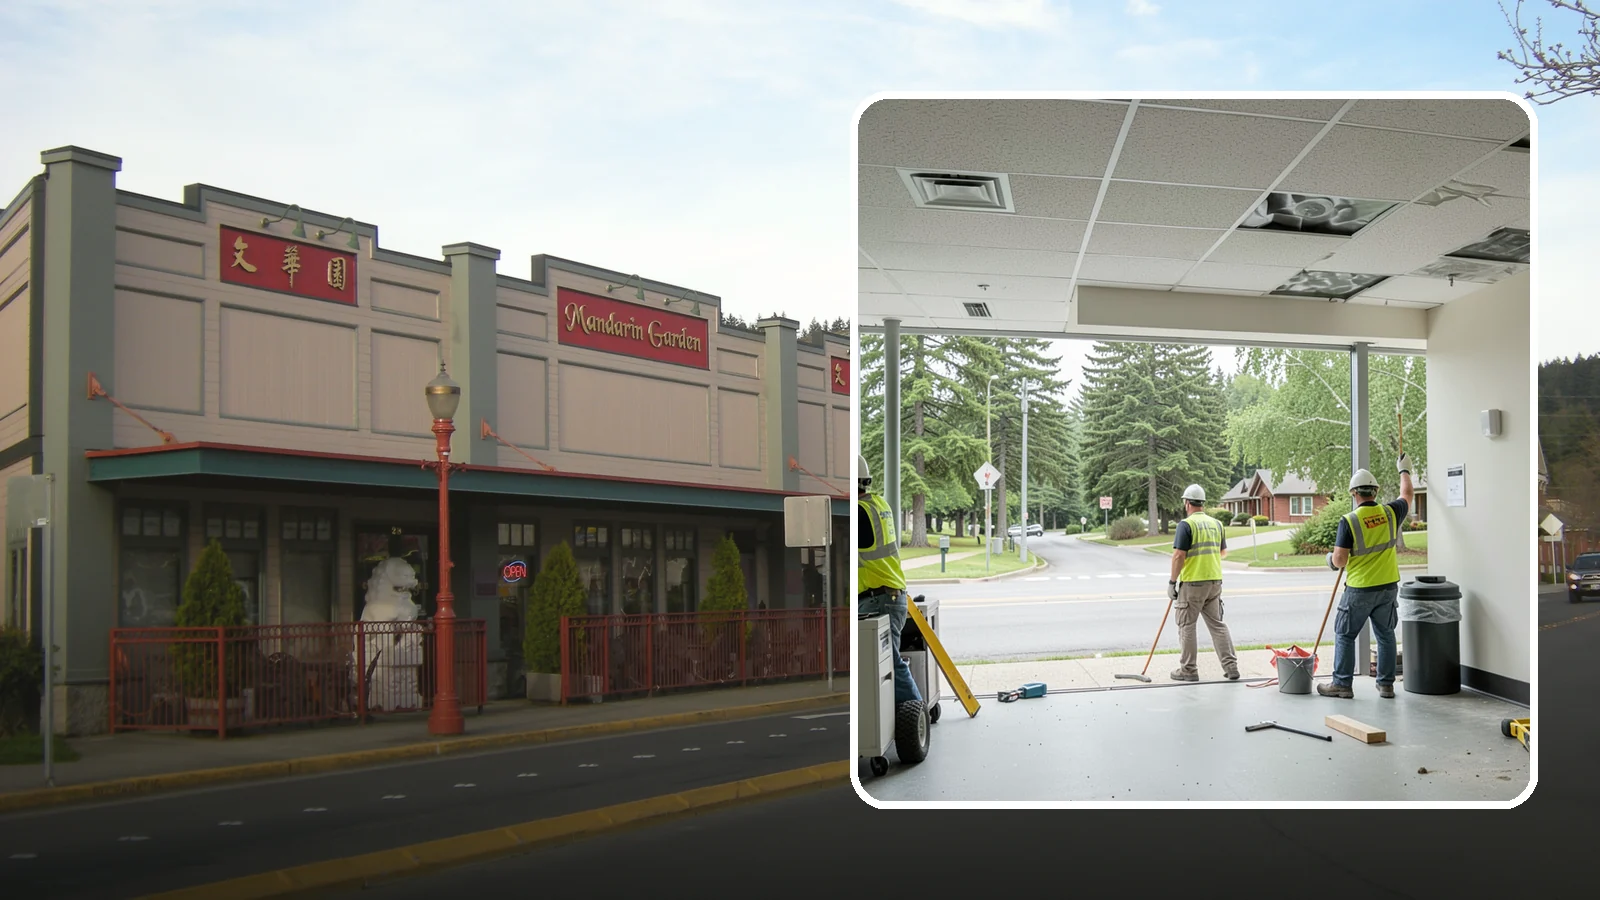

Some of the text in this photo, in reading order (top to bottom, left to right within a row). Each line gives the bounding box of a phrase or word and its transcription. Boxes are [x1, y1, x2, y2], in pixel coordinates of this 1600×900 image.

[231, 235, 346, 291] 文華園
[564, 302, 702, 352] Mandarin Garden
[503, 565, 527, 578] OPEN
